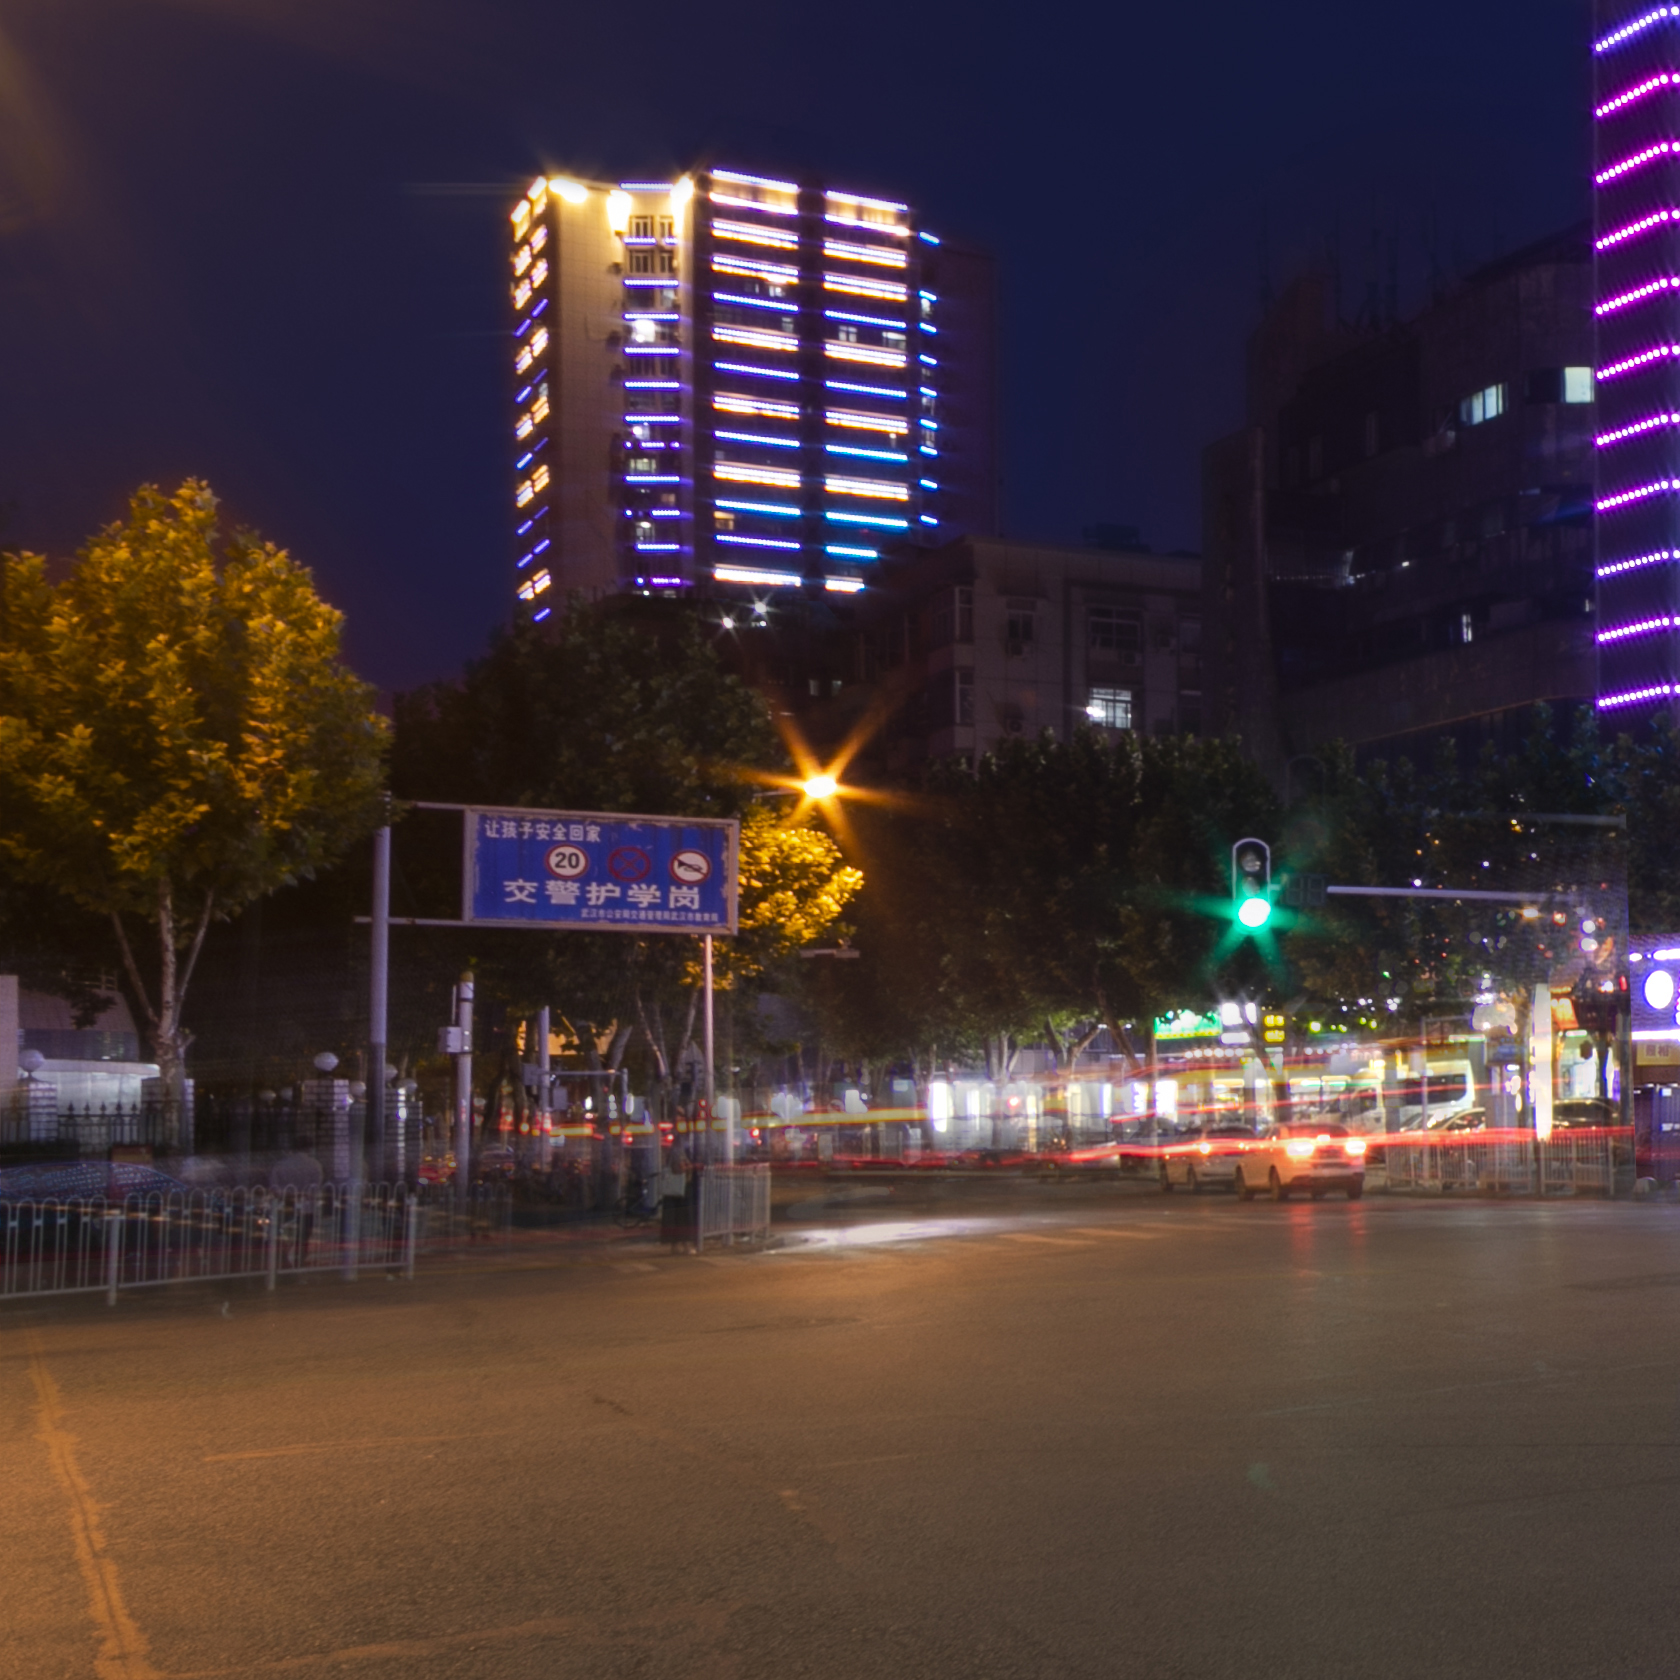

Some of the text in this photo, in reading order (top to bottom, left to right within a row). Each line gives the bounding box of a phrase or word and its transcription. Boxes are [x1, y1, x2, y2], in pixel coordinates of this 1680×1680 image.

[485, 819, 602, 843] 让孩子安全回家
[554, 851, 581, 870] 20
[503, 877, 701, 910] 交警护学岗
